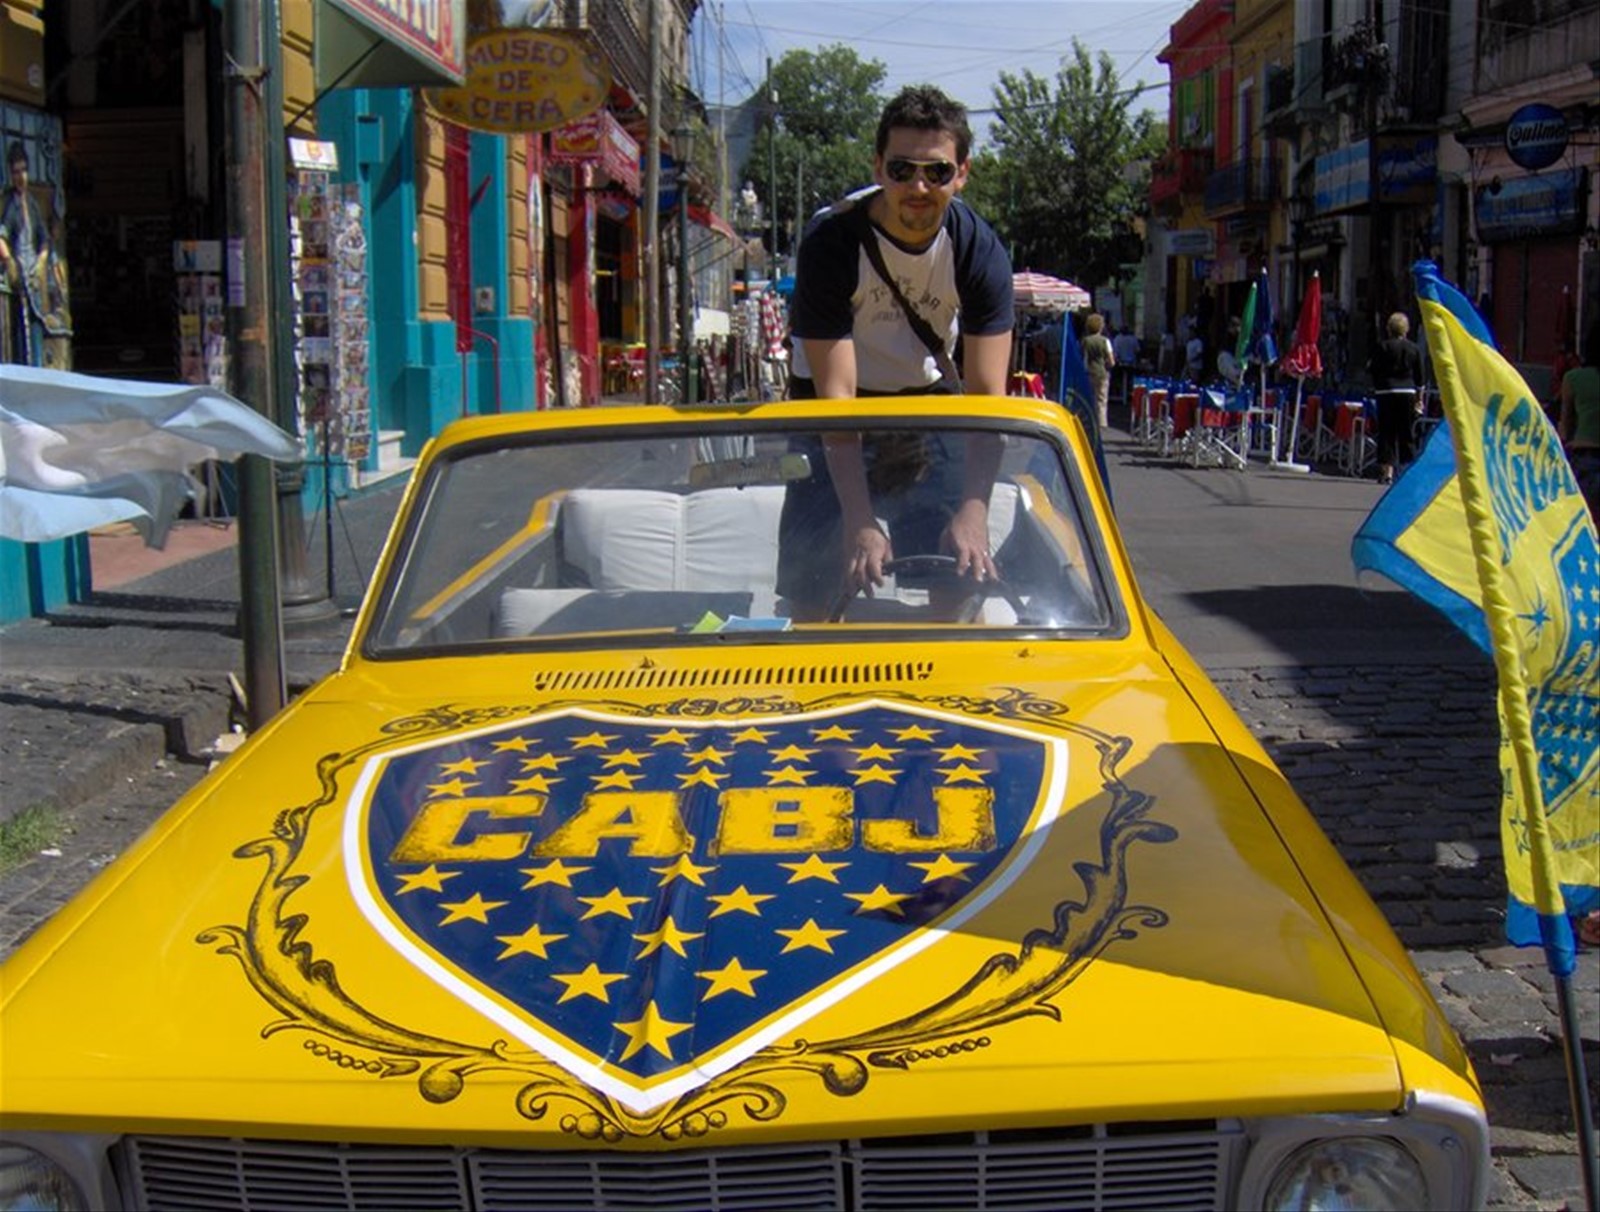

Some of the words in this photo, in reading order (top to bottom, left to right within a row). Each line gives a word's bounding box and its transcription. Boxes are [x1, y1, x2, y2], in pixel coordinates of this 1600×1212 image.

[466, 39, 570, 68] MUSEO
[498, 70, 534, 93] DE
[469, 94, 564, 123] CERA
[389, 784, 997, 864] CABJ
